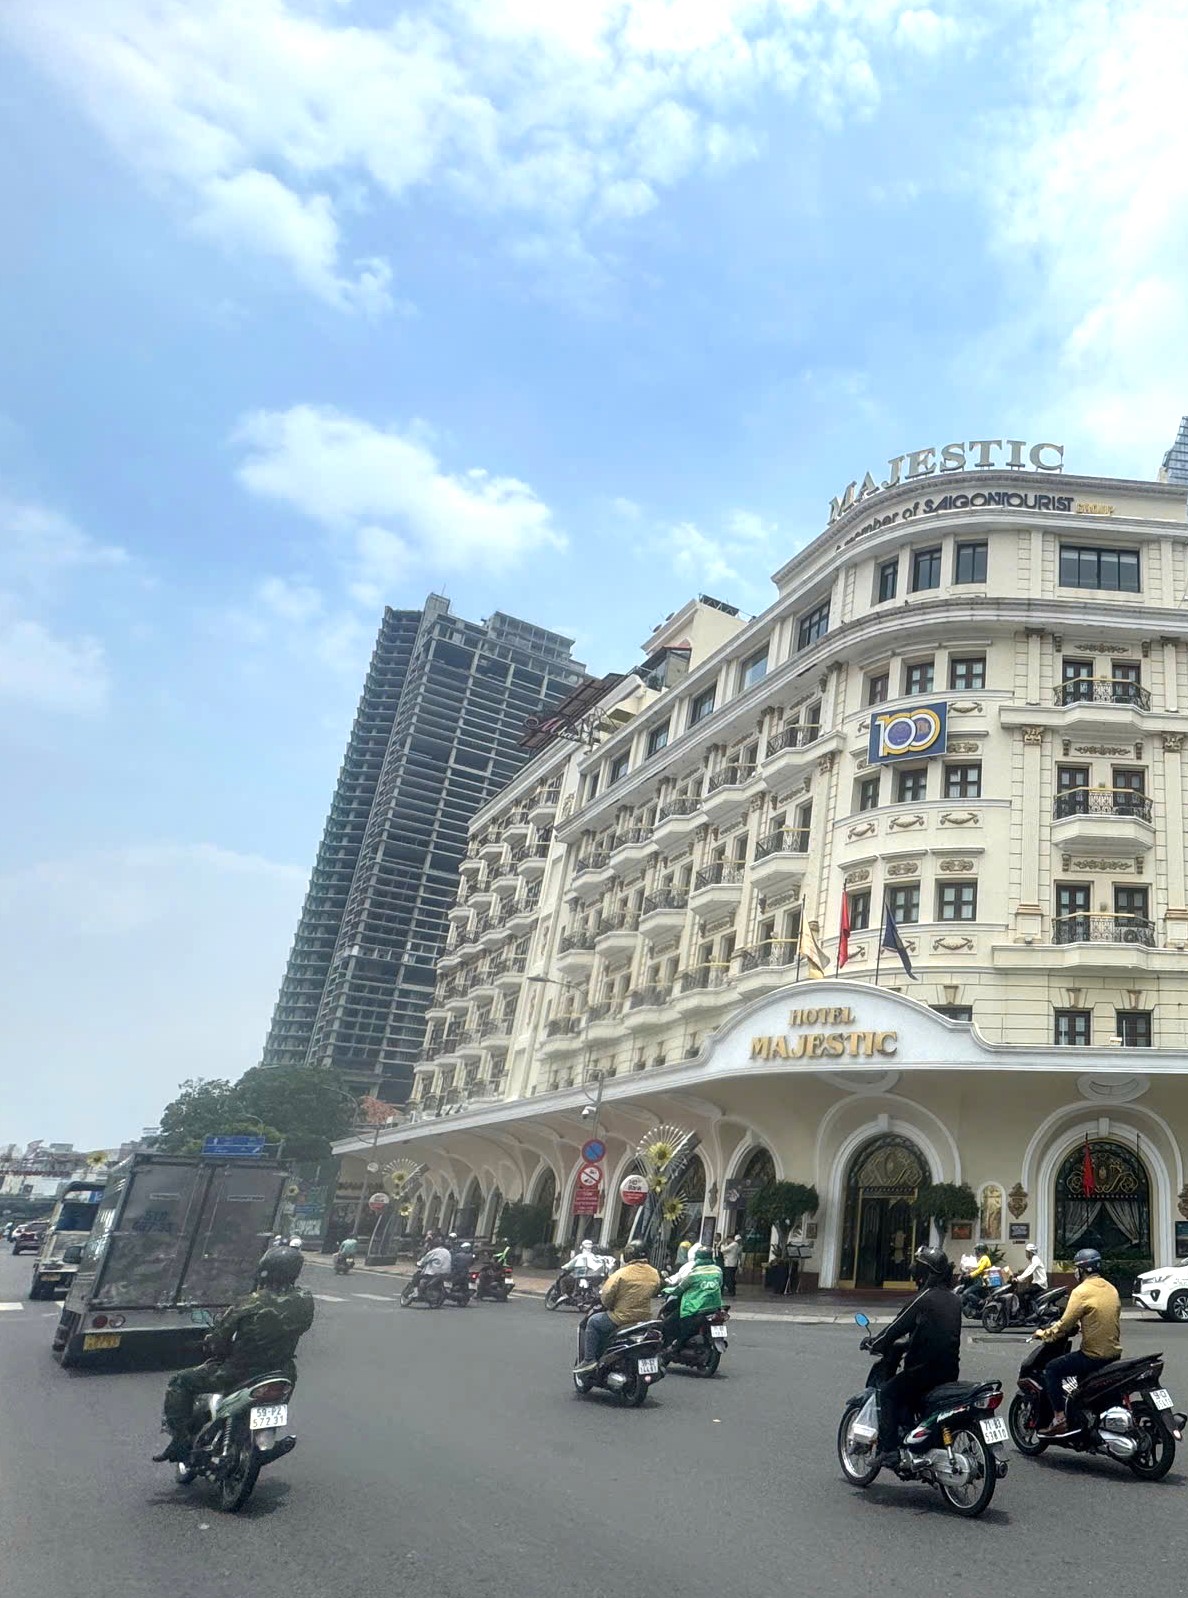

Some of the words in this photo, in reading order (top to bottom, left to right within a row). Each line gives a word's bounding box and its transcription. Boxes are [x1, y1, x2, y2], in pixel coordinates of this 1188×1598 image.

[827, 439, 1064, 526] MAJESTIC
[844, 511, 899, 546] member
[902, 501, 920, 520] of
[922, 490, 1075, 513] SAIGONTOURIST
[788, 1006, 856, 1027] HOTEL
[749, 1031, 898, 1060] MAJESTIC
[253, 1415, 284, 1428] 57231
